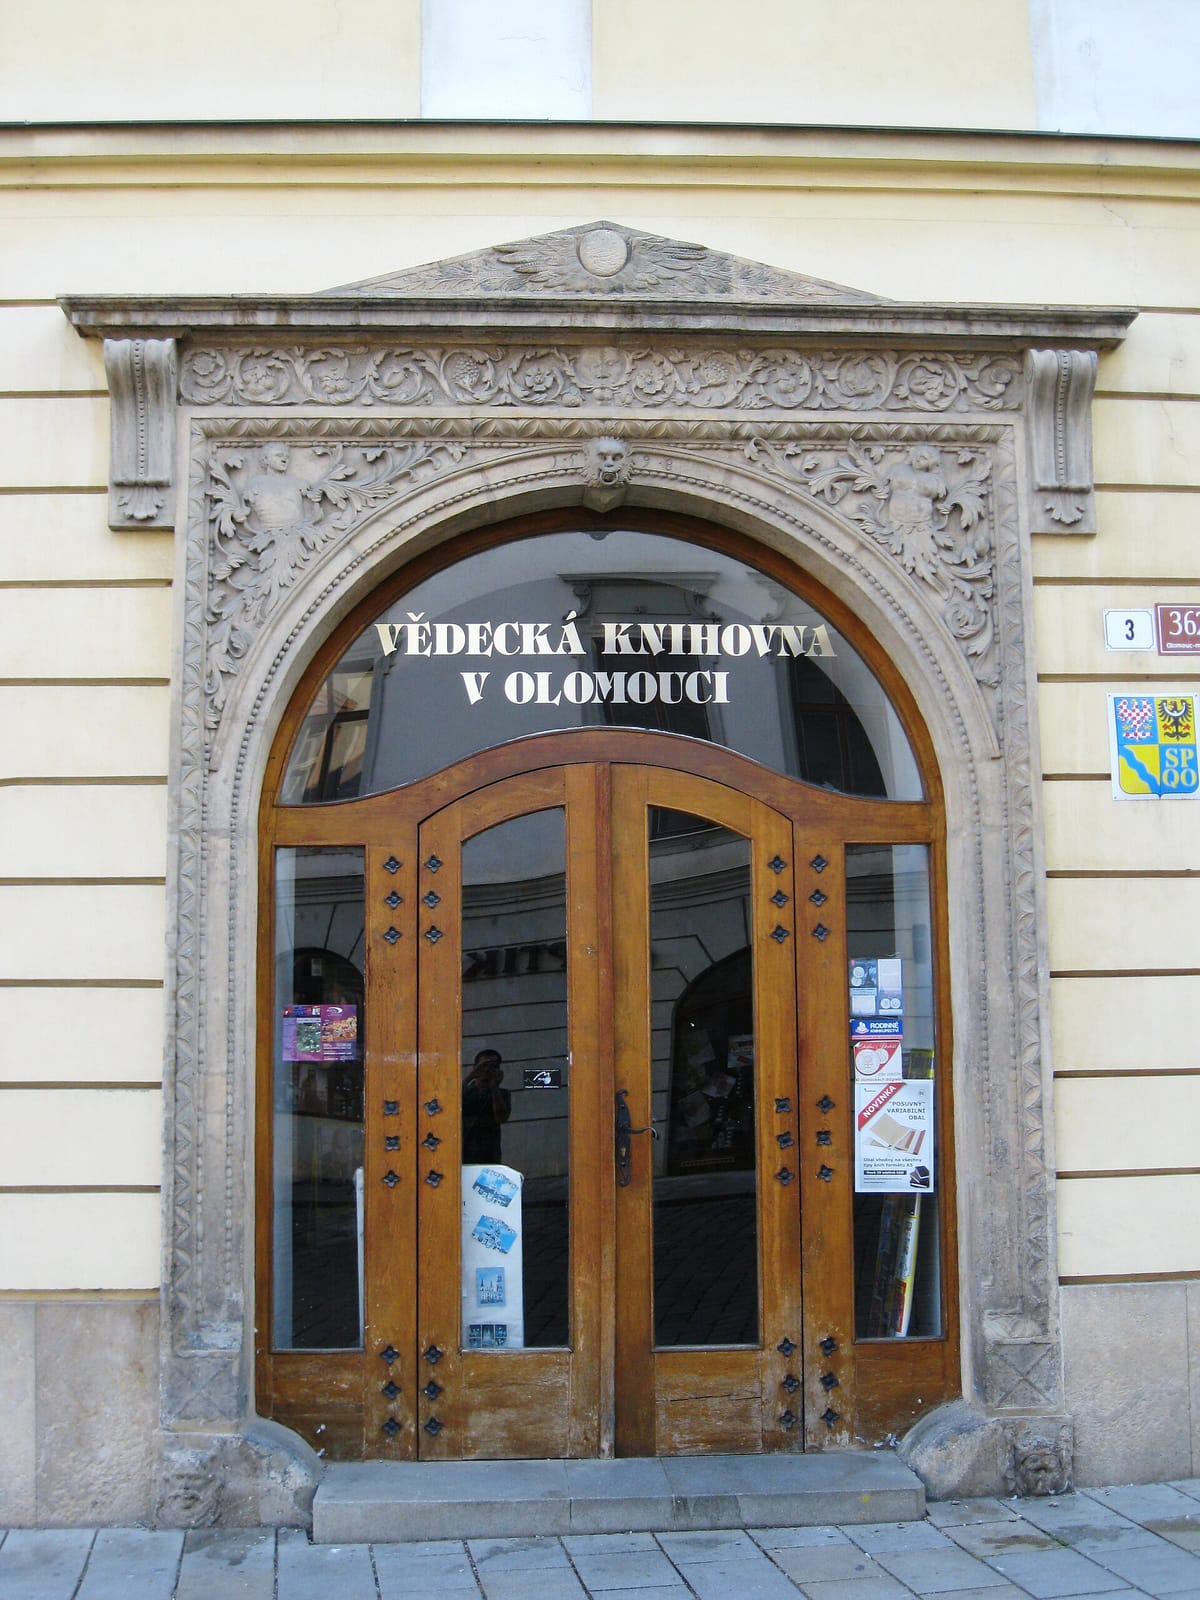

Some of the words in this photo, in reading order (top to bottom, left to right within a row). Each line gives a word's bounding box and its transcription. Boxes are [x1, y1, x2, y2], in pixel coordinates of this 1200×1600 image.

[374, 610, 587, 657] VĚDECKÁ
[600, 623, 838, 657] KNIHOVNA
[1125, 619, 1135, 641] 3
[459, 671, 490, 705] V
[504, 670, 731, 705] OLOMOUCI
[1164, 748, 1195, 769] SP
[1162, 768, 1197, 788] QO
[863, 1085, 897, 1119] NOVINKA
